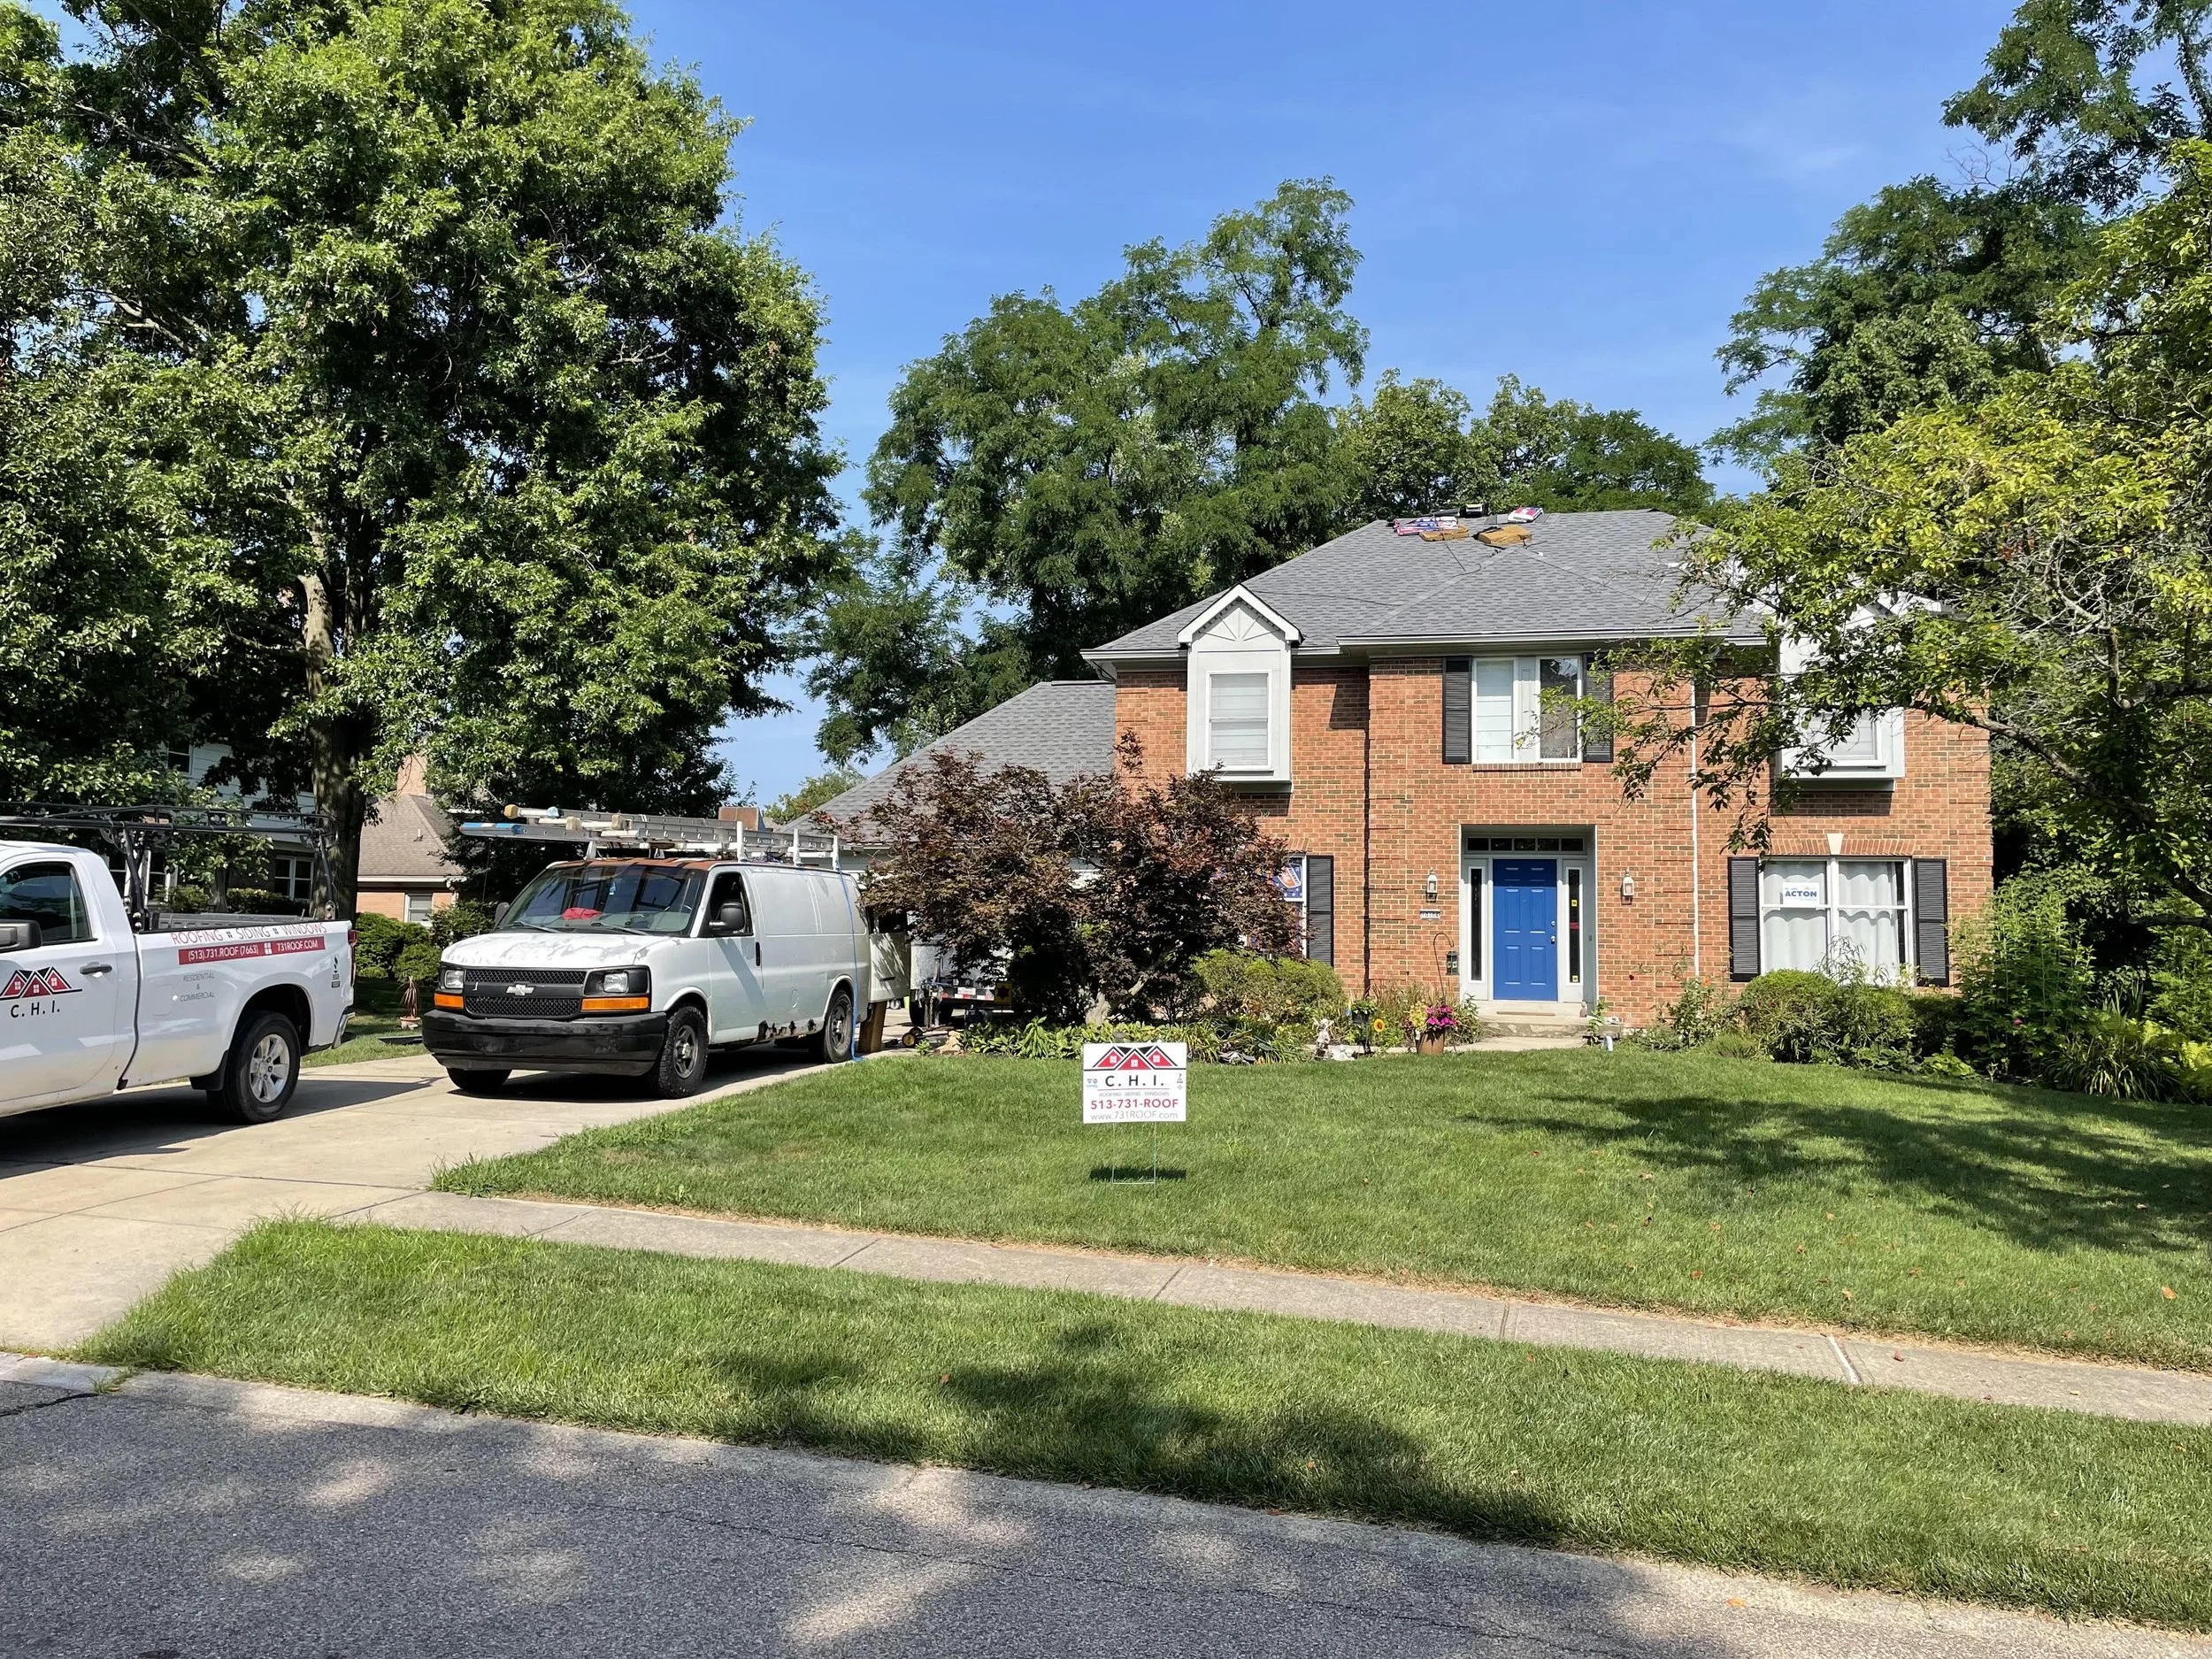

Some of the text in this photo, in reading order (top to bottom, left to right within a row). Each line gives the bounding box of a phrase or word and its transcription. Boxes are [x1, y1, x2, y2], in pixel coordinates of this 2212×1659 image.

[170, 922, 326, 944] ROOFING SIDING WINDOWS
[240, 944, 259, 956] (7663)
[276, 940, 319, 952] 731ROOF.COM
[1091, 1099, 1179, 1110] 513-731-ROOF
[1091, 1110, 1178, 1120] www.731ROOF.com
